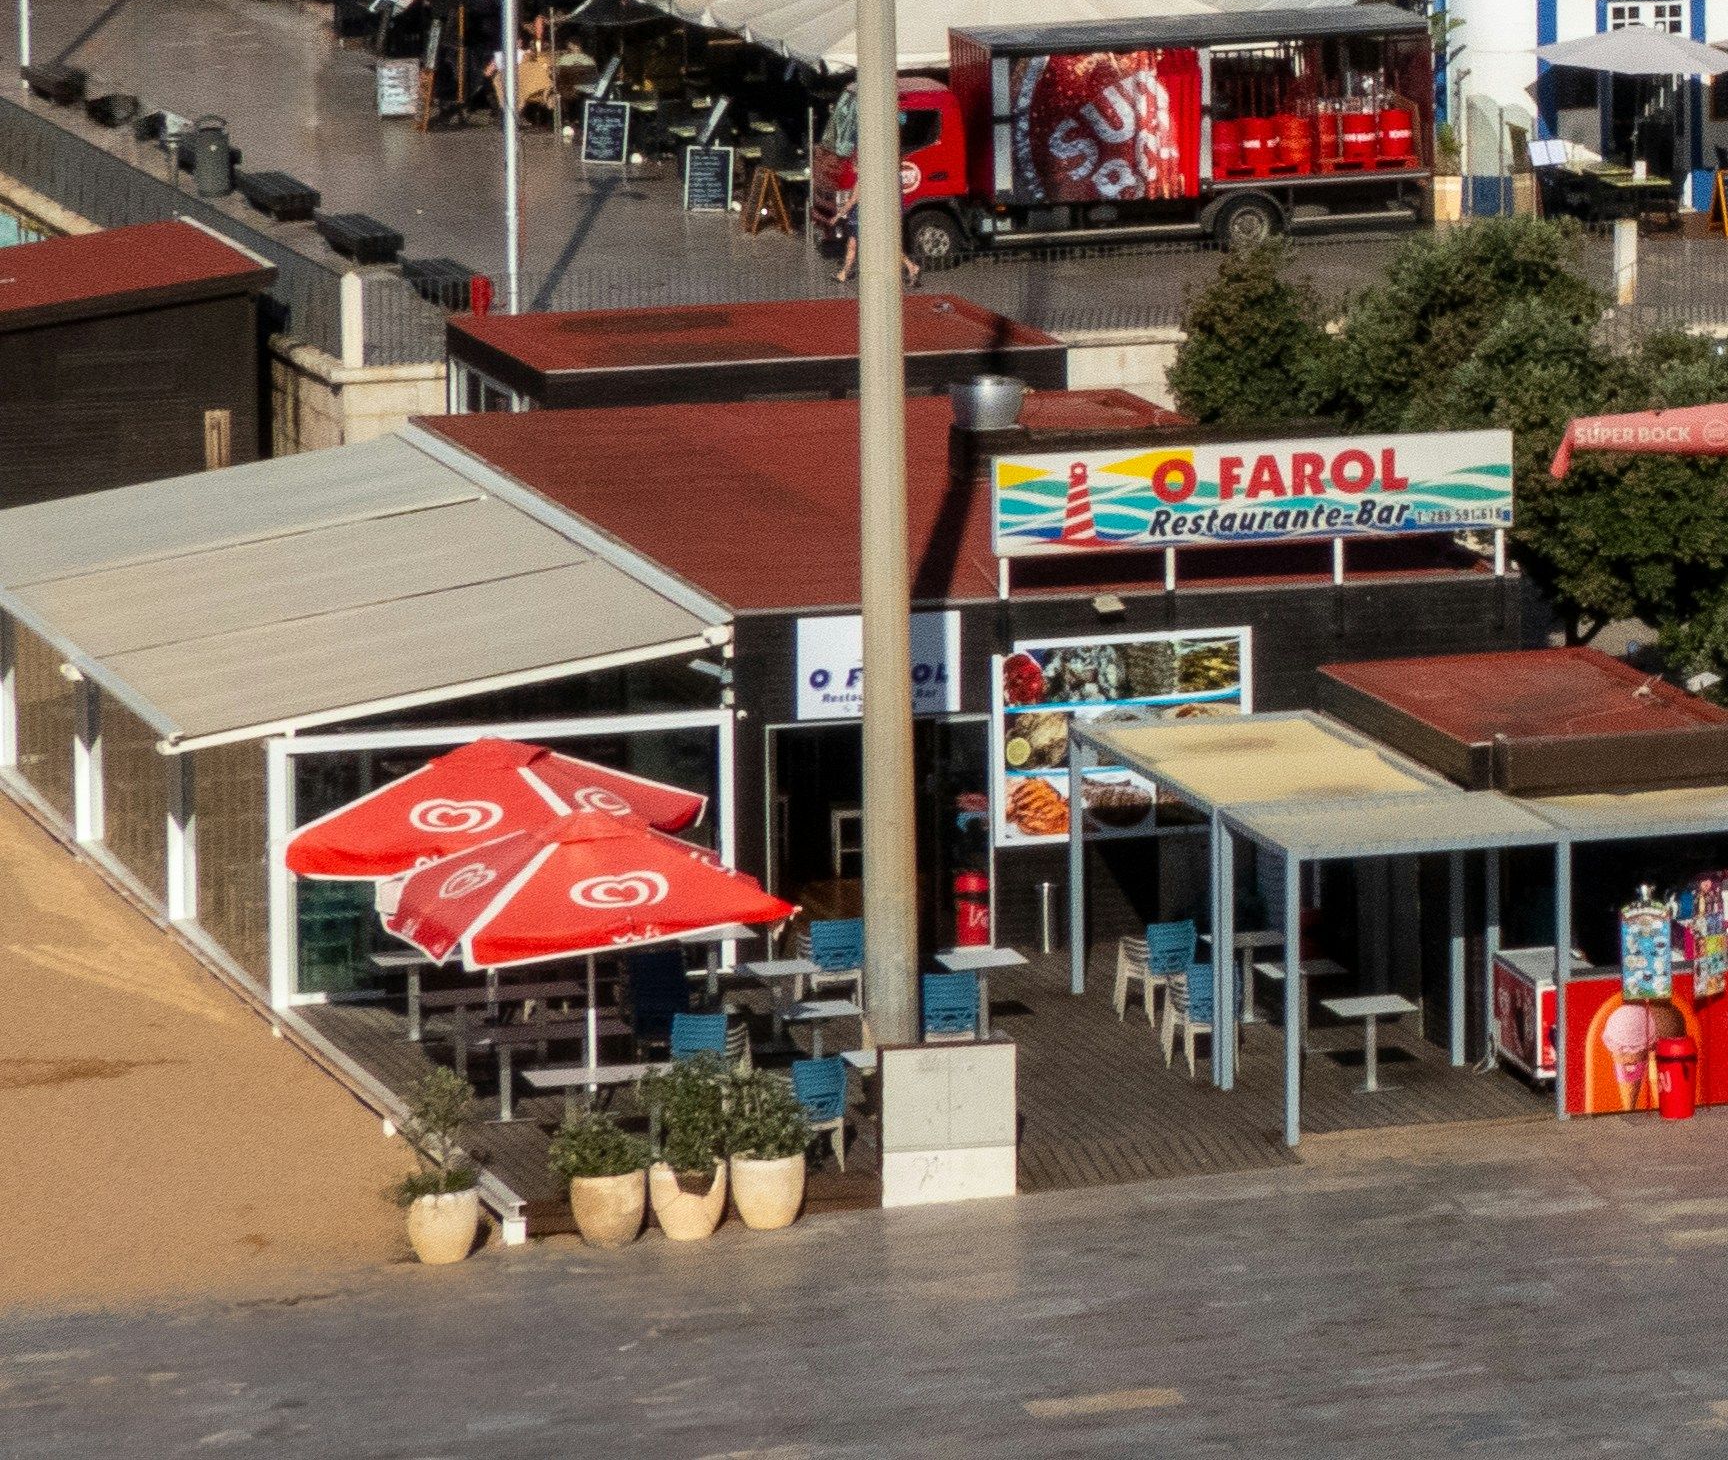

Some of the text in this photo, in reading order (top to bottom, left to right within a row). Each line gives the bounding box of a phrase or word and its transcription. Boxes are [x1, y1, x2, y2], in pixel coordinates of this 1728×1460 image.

[1152, 446, 1410, 504] O FAROL
[809, 668, 830, 690] O
